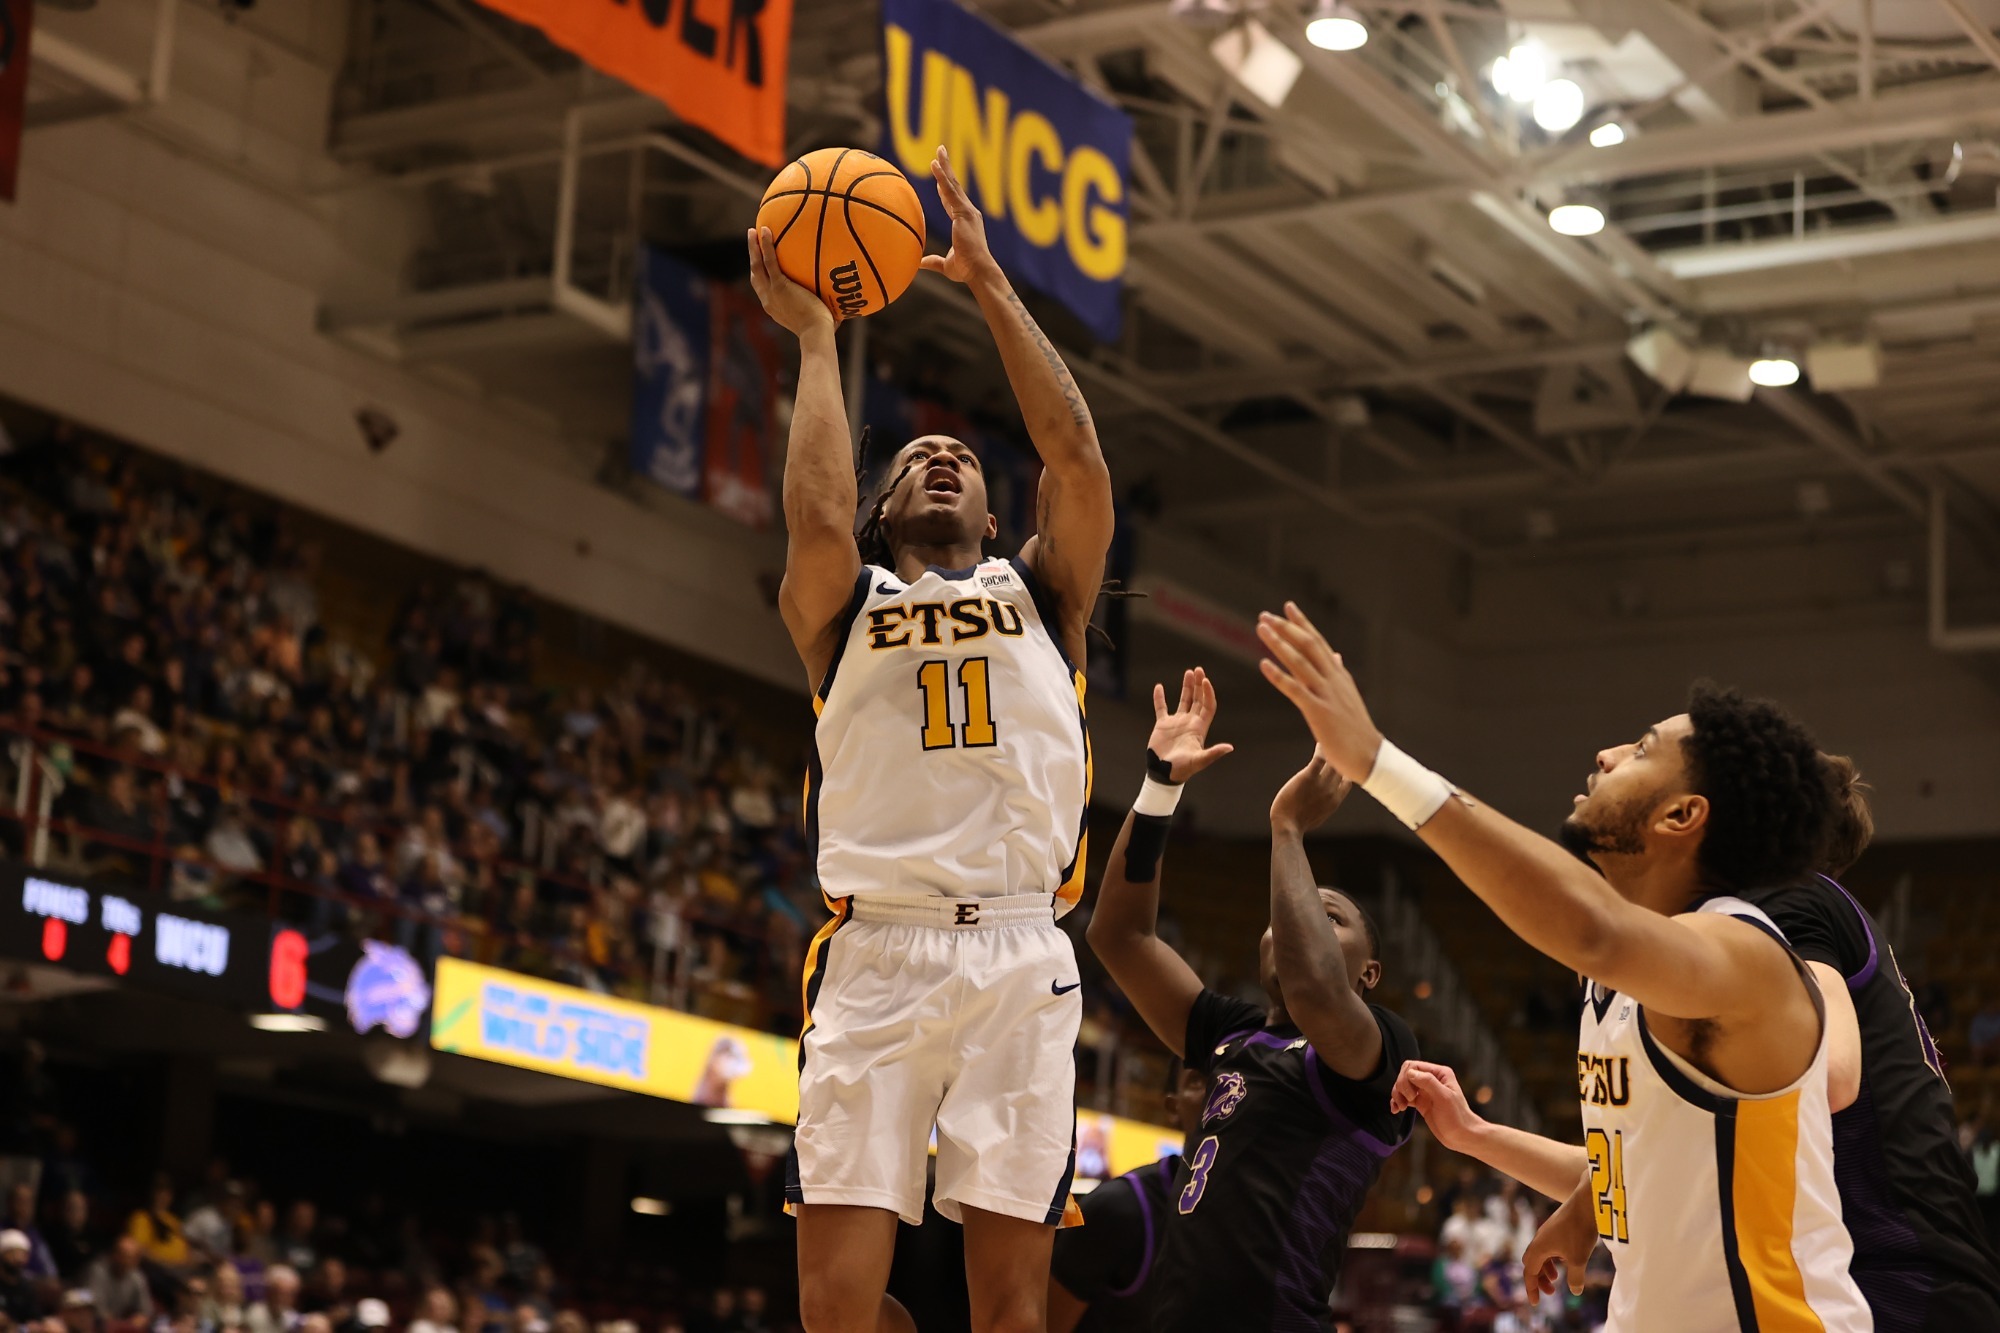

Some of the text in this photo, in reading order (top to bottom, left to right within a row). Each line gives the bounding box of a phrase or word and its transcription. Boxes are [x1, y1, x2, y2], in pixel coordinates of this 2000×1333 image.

[885, 22, 1127, 282] UNCG
[866, 597, 1025, 651] ETSU
[917, 656, 997, 751] 11
[954, 903, 980, 926] E
[269, 928, 309, 1010] 6
[482, 1007, 568, 1062] WILD
[571, 1024, 648, 1080] SIDE
[1178, 1135, 1220, 1215] 3
[1584, 1128, 1630, 1244] 24
